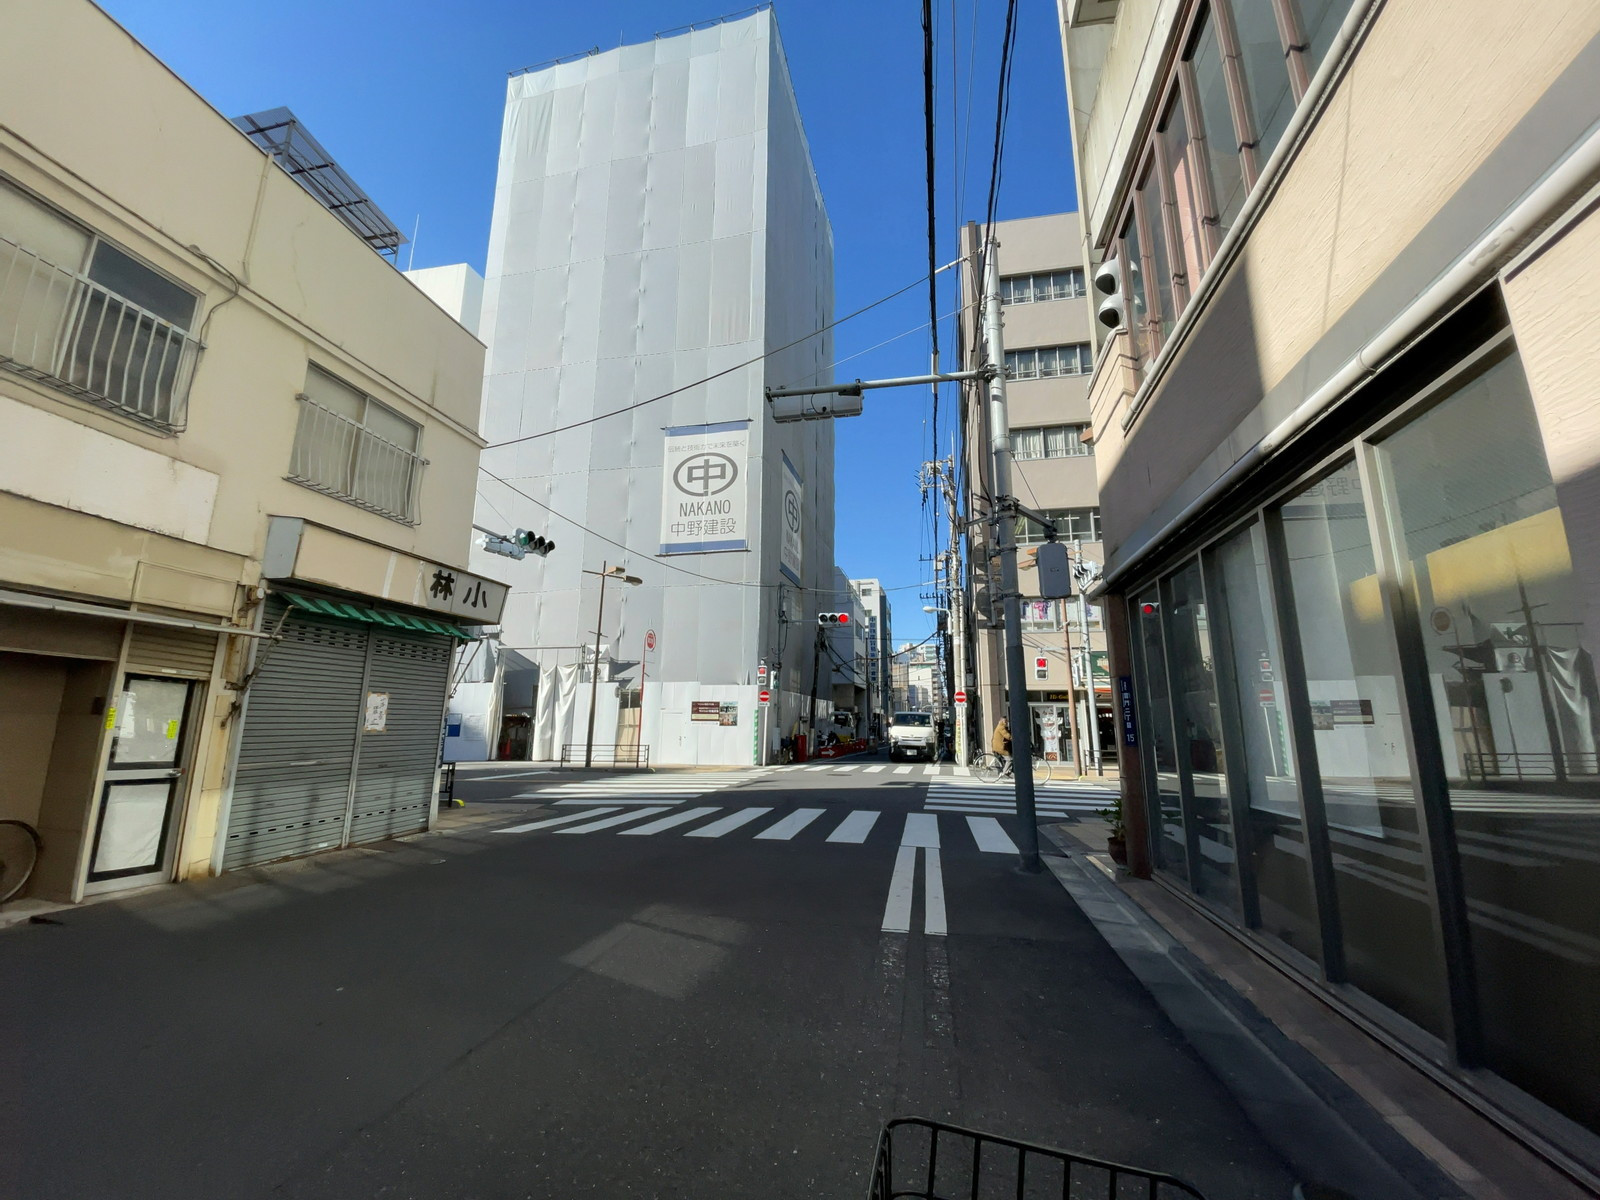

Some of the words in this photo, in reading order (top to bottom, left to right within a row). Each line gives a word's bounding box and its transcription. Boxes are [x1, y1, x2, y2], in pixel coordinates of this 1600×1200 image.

[680, 499, 731, 517] NAKANO
[671, 518, 736, 536] 中野建設
[1126, 733, 1134, 741] 15
